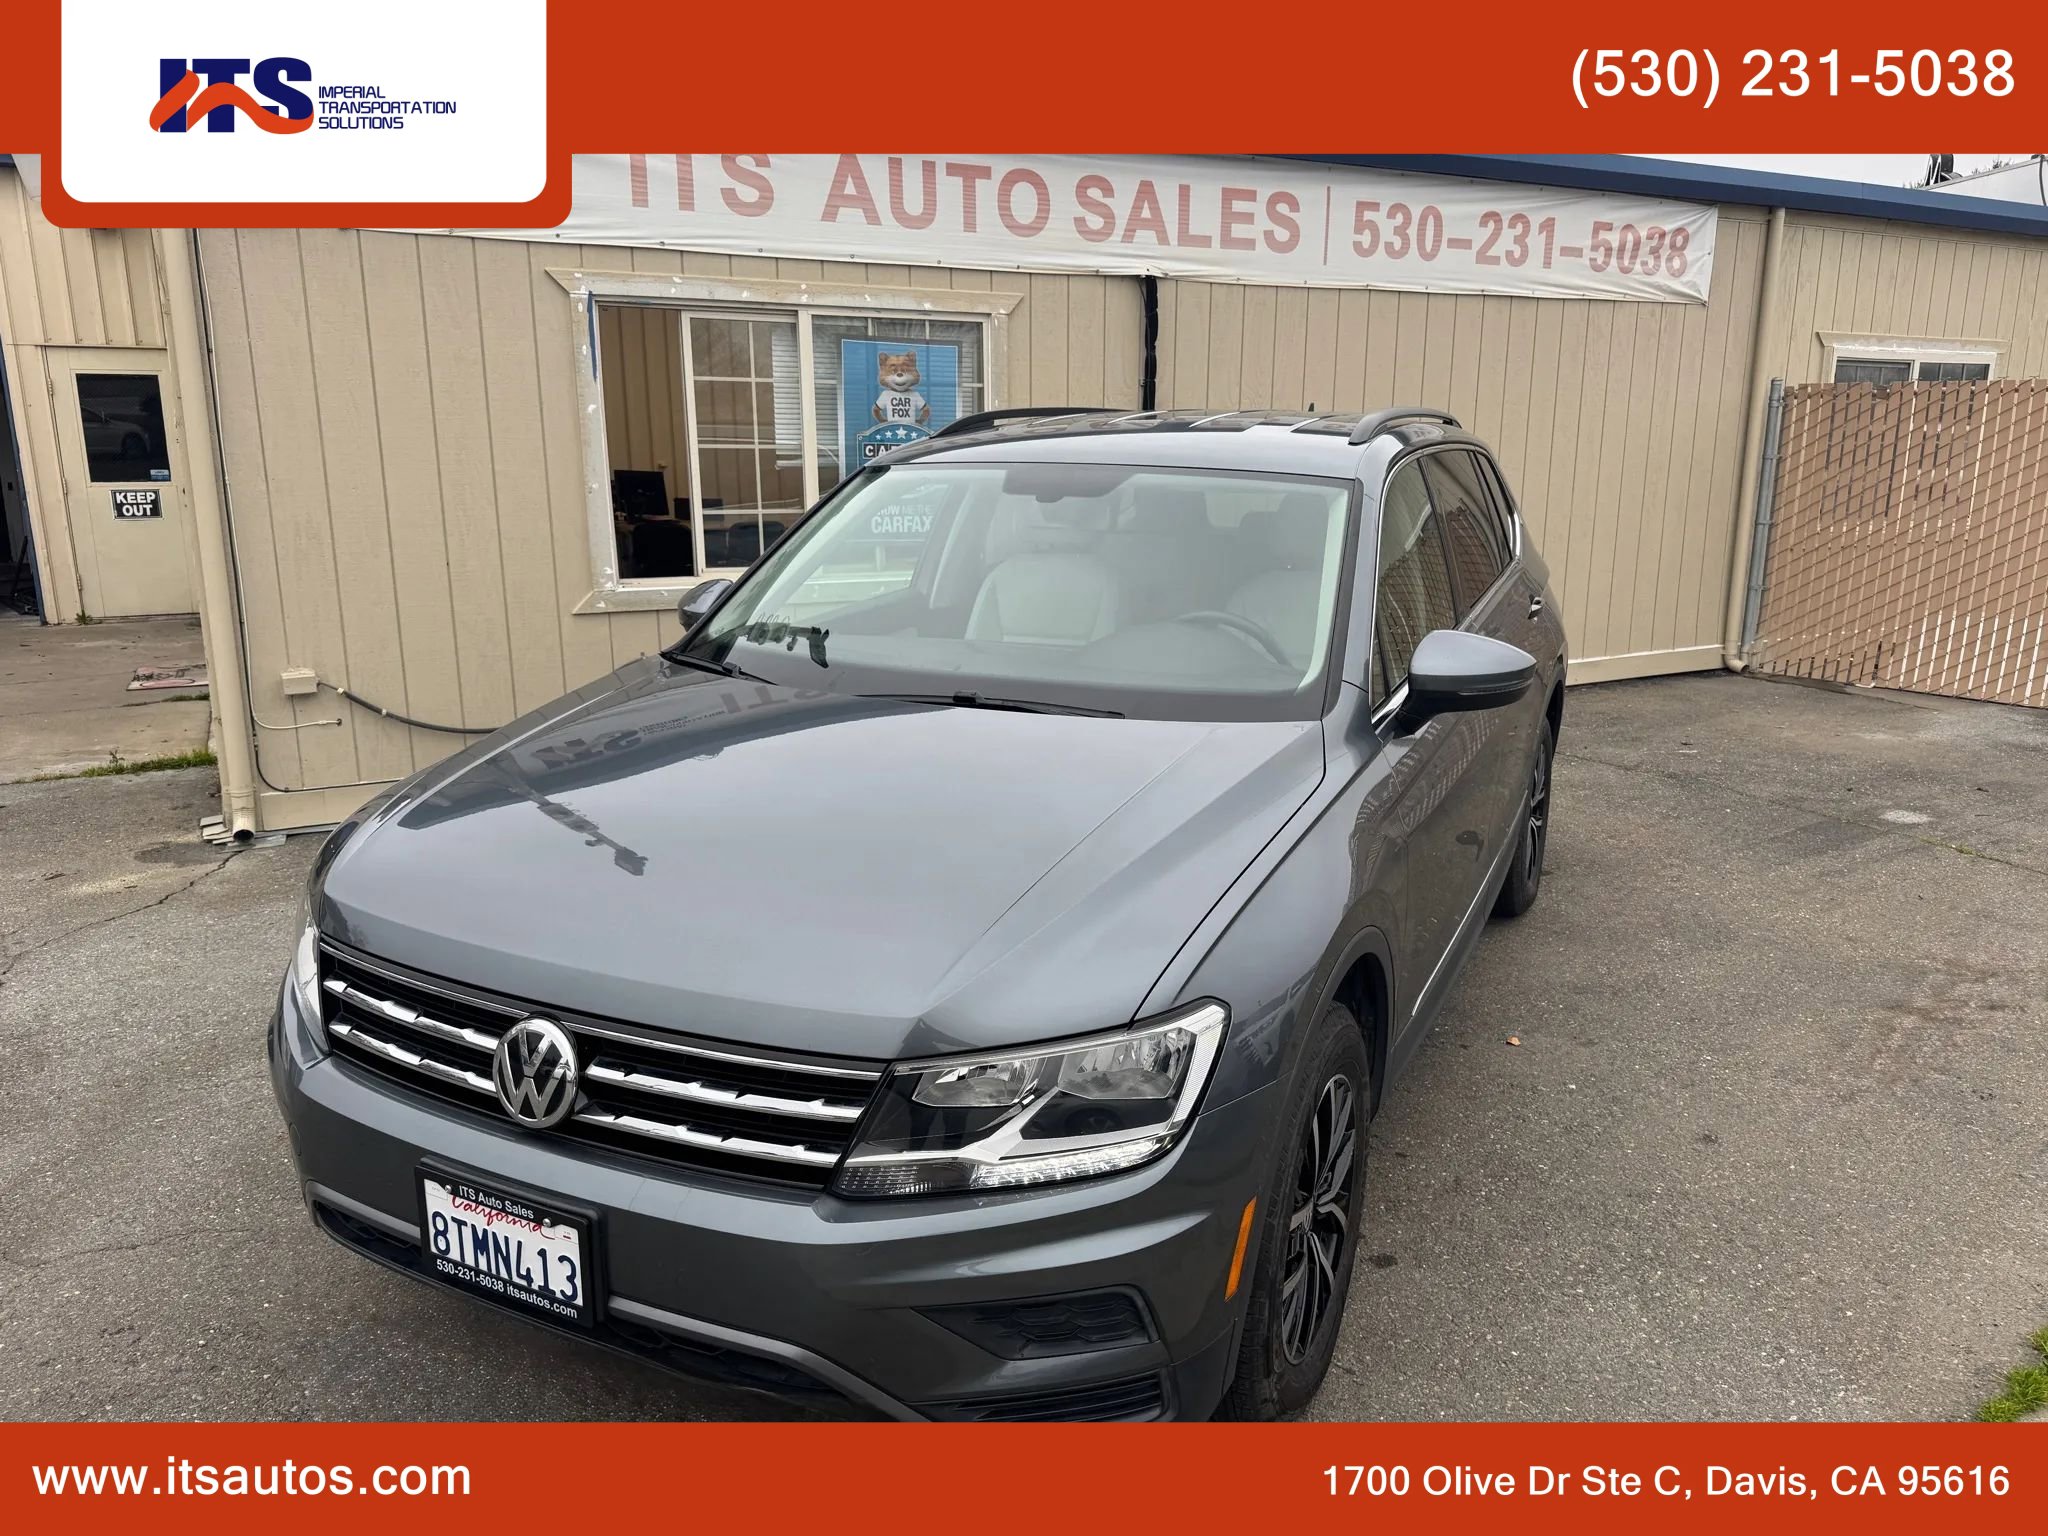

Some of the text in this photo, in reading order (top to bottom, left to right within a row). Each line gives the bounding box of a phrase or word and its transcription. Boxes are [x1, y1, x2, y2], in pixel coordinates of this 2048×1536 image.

[820, 154, 1051, 238] AUTO
[1073, 174, 1301, 254] SALES
[1352, 199, 1691, 279] 530-231-5038
[890, 396, 911, 408] CAR
[891, 408, 911, 418] FOX
[115, 491, 156, 504] KEEP
[122, 504, 153, 516] OUT
[871, 515, 934, 534] CARFAX
[458, 1184, 477, 1201] ITS
[478, 1195, 503, 1210] Auto
[504, 1201, 535, 1220] Sales
[431, 1210, 580, 1303] 8TMN413
[436, 1258, 579, 1320] 530-231-5038 itsautos.com
